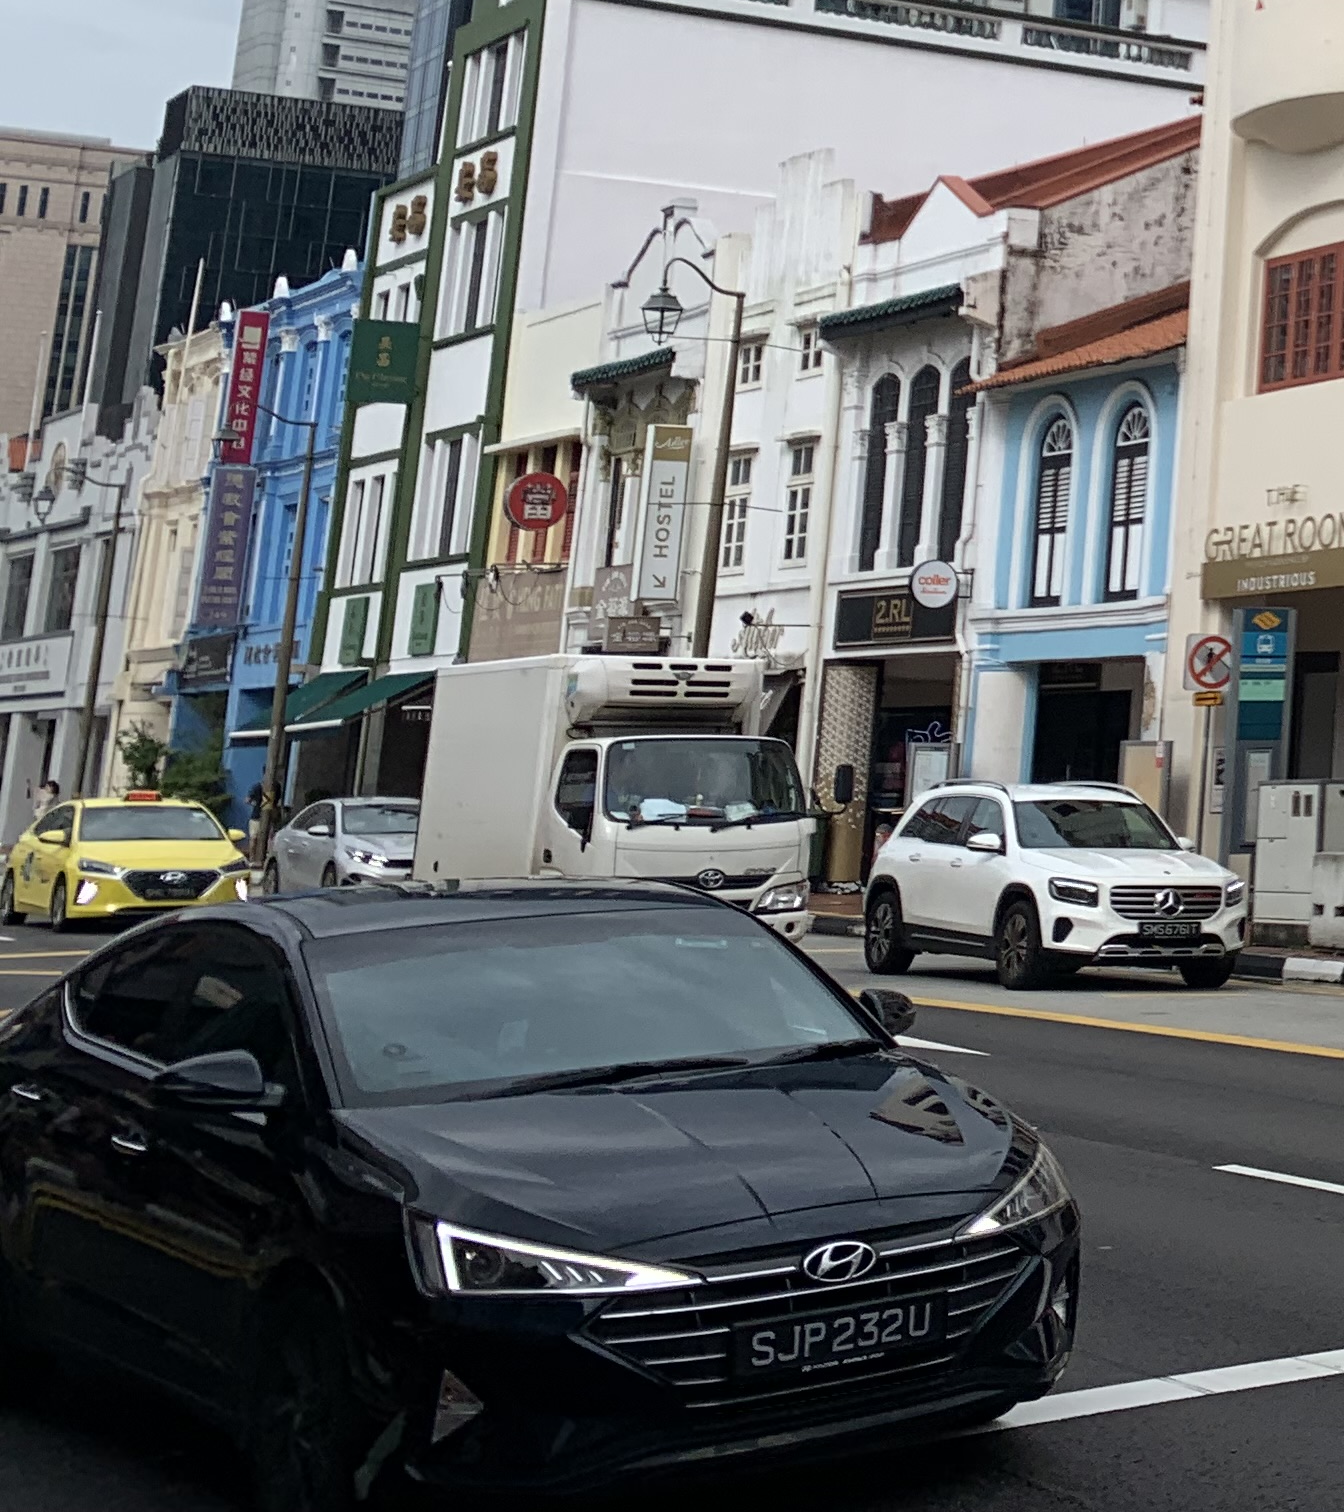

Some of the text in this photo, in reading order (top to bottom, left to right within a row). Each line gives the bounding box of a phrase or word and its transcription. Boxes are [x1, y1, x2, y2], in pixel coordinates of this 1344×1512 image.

[1266, 484, 1309, 506] THE
[652, 475, 677, 559] HOSTEL
[1204, 521, 1279, 561] GREAT
[1237, 571, 1317, 592] INDUSTRIOUS
[1141, 923, 1199, 936] SMS6761T
[750, 1302, 932, 1367] SJP232U
